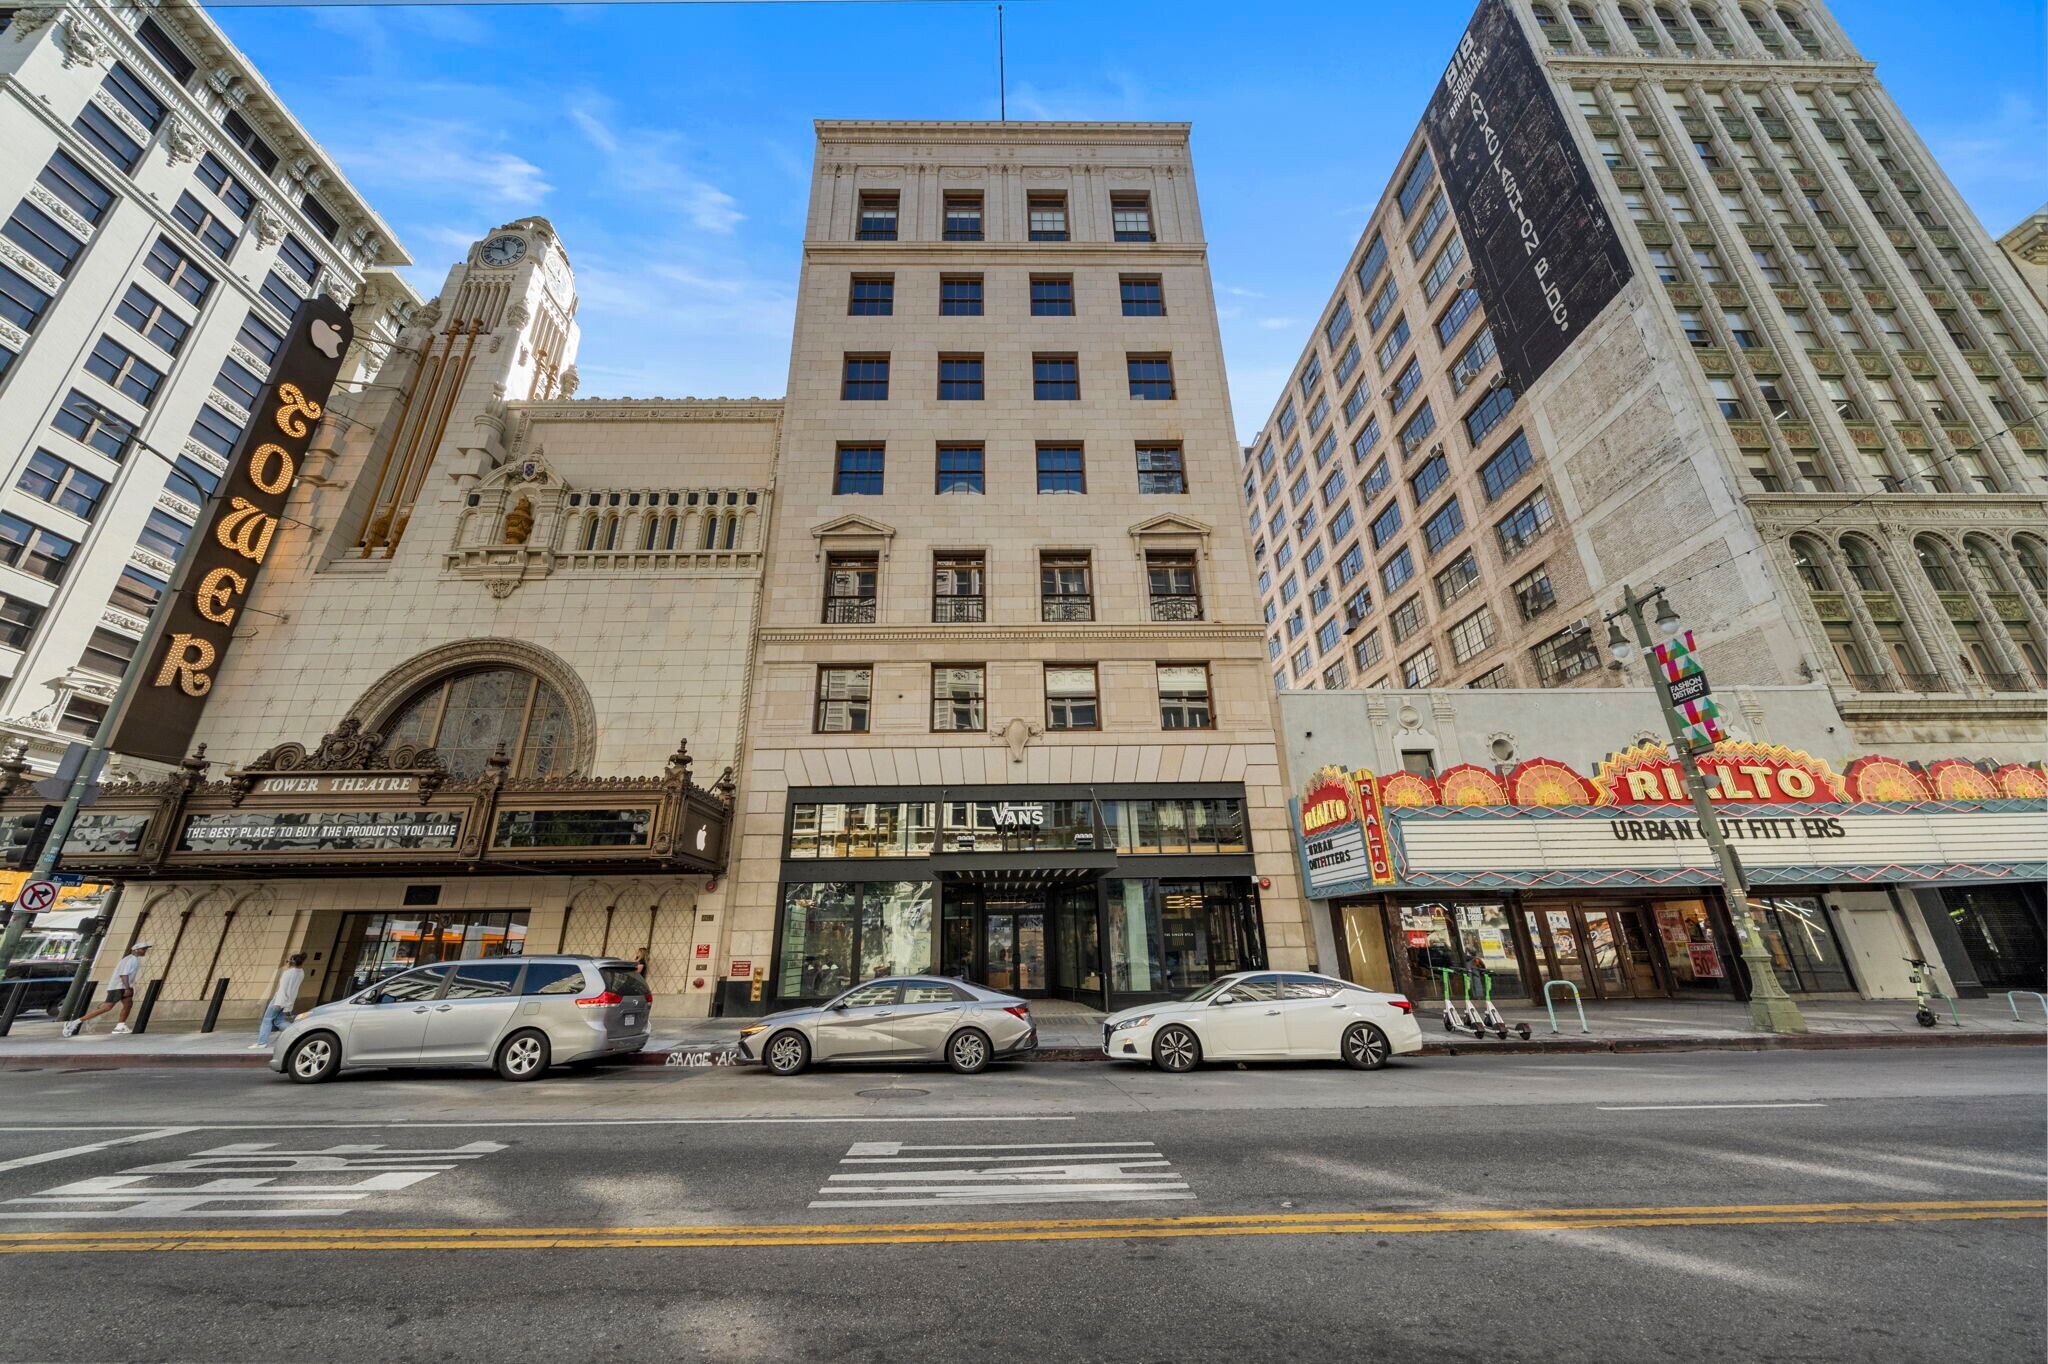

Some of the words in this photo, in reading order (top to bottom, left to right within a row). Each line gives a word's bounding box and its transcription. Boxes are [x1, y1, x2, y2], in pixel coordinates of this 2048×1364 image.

[1445, 31, 1474, 89] 818
[1452, 51, 1477, 98] SOUTH
[1494, 148, 1539, 256] FASHION
[1534, 257, 1568, 331] BLDG.
[154, 382, 321, 697] TOWER
[1670, 675, 1702, 694] FASHION
[1672, 682, 1703, 700] DISTRICT
[262, 778, 319, 792] TOWER
[330, 777, 412, 792] THEATRE
[991, 806, 1044, 825] VANS
[1304, 799, 1347, 831] RIALTO
[186, 826, 206, 838] THE
[208, 826, 236, 838] BEST
[240, 826, 274, 838] PLACE
[279, 825, 293, 838] TO
[295, 826, 319, 838] BUY
[322, 825, 342, 837] THE
[345, 825, 399, 837] PRODUCTS
[403, 825, 424, 837] YOU
[427, 824, 457, 836] LOVE
[1360, 784, 1387, 874] RIALTO
[1611, 819, 1695, 841] URBAN
[1308, 839, 1333, 855] URBAN
[1308, 850, 1351, 870] OUTFITTERS
